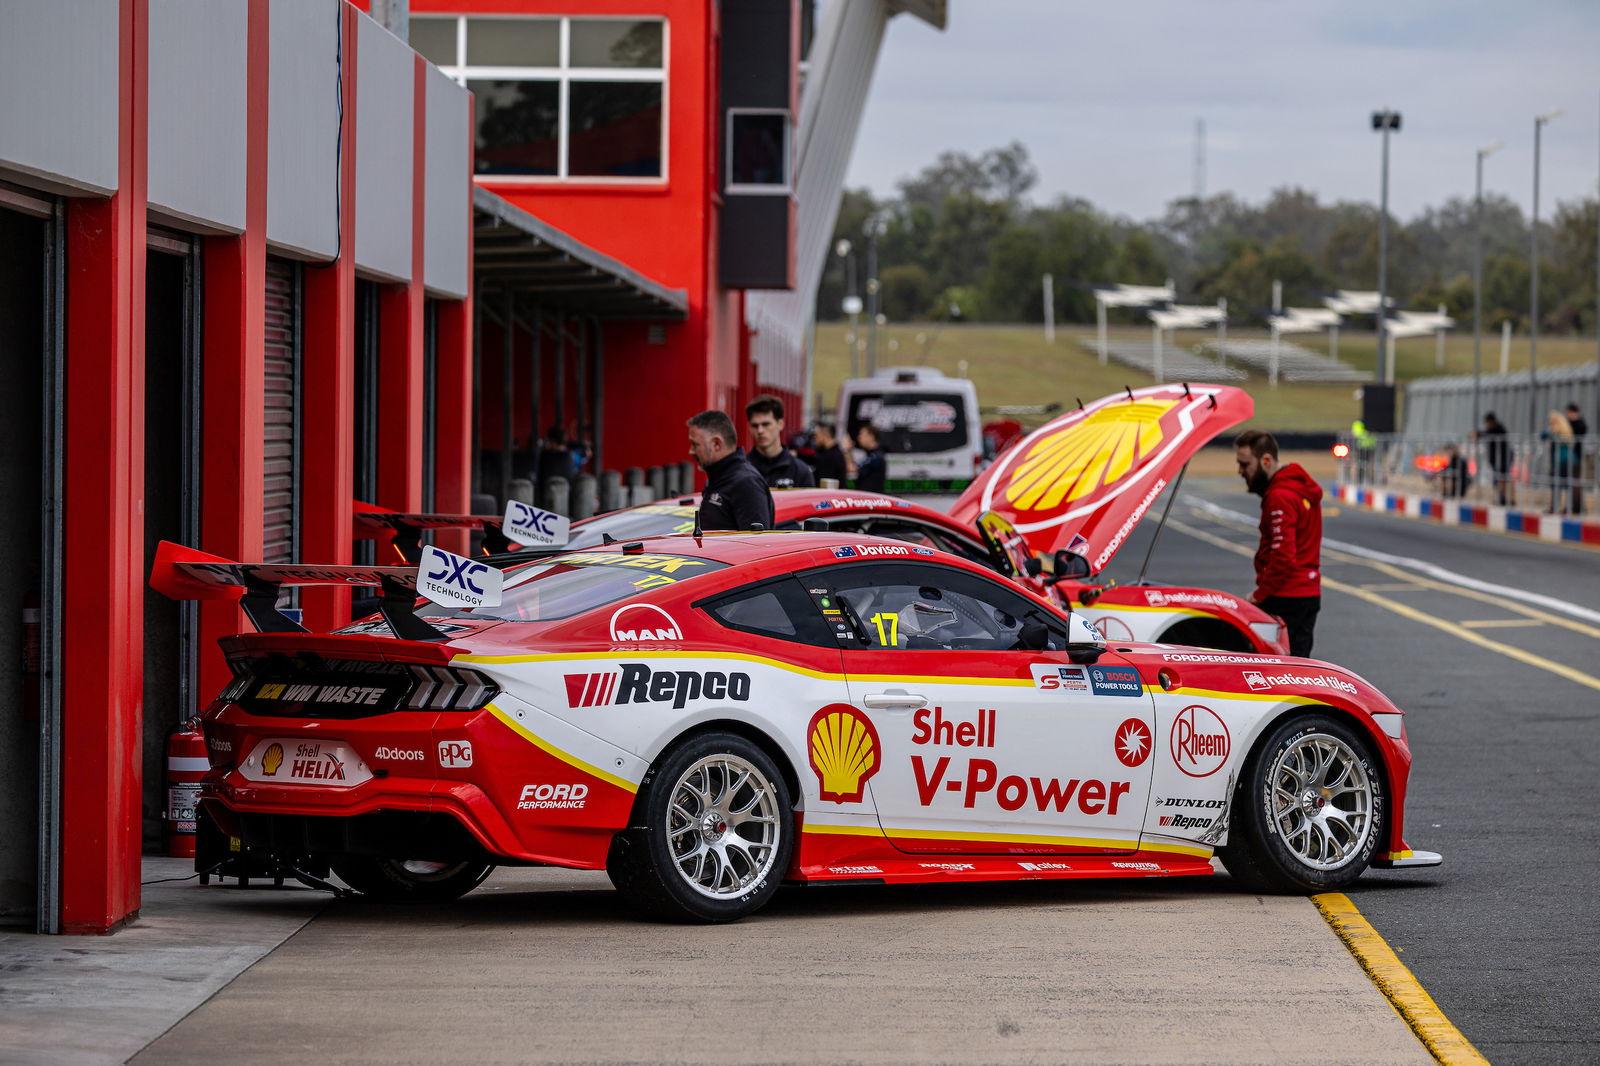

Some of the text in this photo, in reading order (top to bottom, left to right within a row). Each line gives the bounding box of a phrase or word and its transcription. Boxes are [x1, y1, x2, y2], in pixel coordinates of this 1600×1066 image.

[832, 498, 847, 509] De
[512, 504, 559, 537] DXC
[510, 525, 555, 544] TECHNOLOGY
[855, 543, 909, 557] Davison
[427, 548, 489, 596] DXC
[632, 574, 678, 589] 17
[425, 582, 484, 607] TECHNOLOGY
[615, 627, 678, 642] MAN
[870, 612, 899, 647] 17
[615, 663, 751, 710] Repco
[1095, 682, 1119, 690] POWER
[1119, 683, 1139, 691] TOOLS
[1106, 672, 1137, 682] BOSCH
[282, 684, 387, 705] WM WASTE
[911, 706, 998, 749] Shell
[1176, 708, 1227, 765] Rheem
[295, 743, 321, 758] Shell
[374, 745, 425, 762] 4Ddoors
[439, 743, 472, 767] PPG
[291, 759, 346, 781] HELIX
[519, 784, 589, 801] FORD
[910, 755, 1131, 816] V-Power
[517, 800, 587, 811] PERFORMANCE
[1164, 797, 1227, 810] DUNLOP
[1171, 813, 1213, 830] Repco
[1361, 781, 1384, 862] DUNLOP
